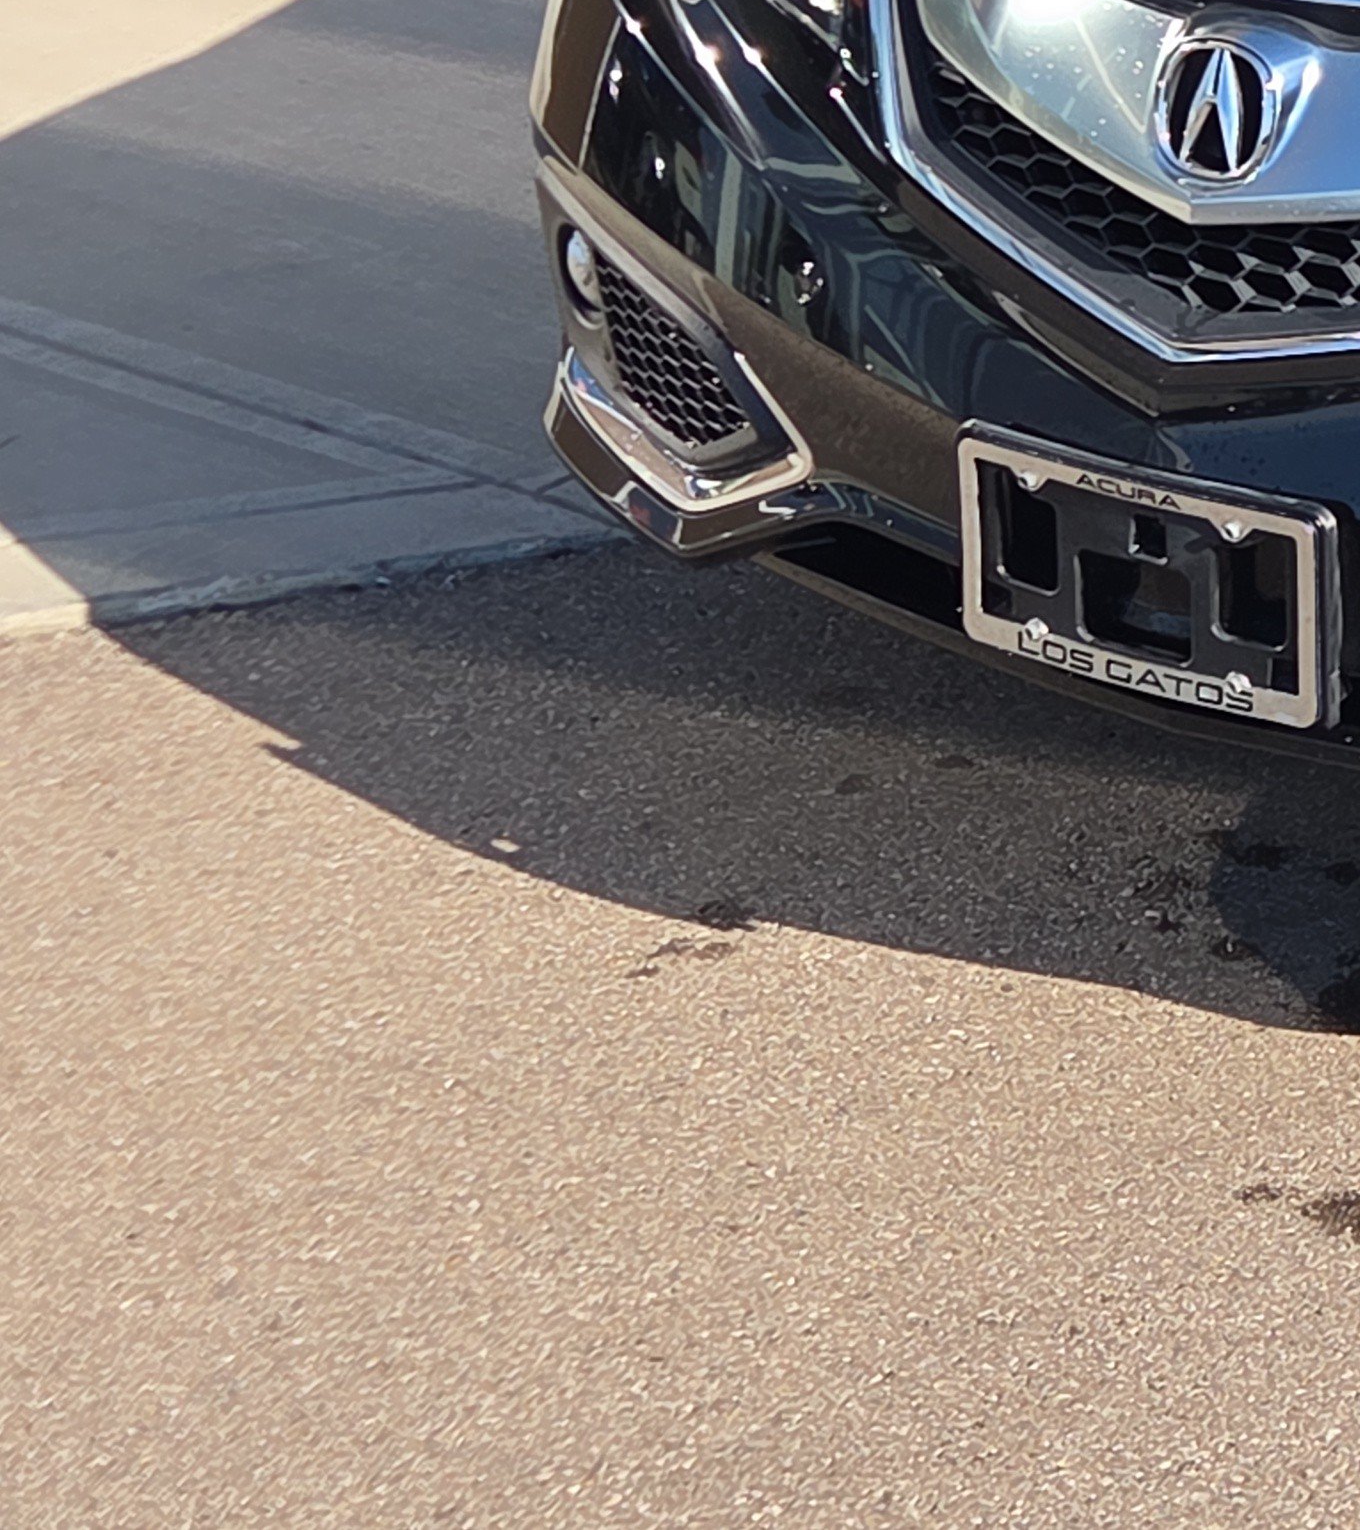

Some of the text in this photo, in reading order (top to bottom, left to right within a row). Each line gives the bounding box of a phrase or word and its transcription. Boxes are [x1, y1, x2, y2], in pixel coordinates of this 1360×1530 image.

[1076, 472, 1181, 509] ACURA
[1017, 630, 1254, 713] LOS GATOS
